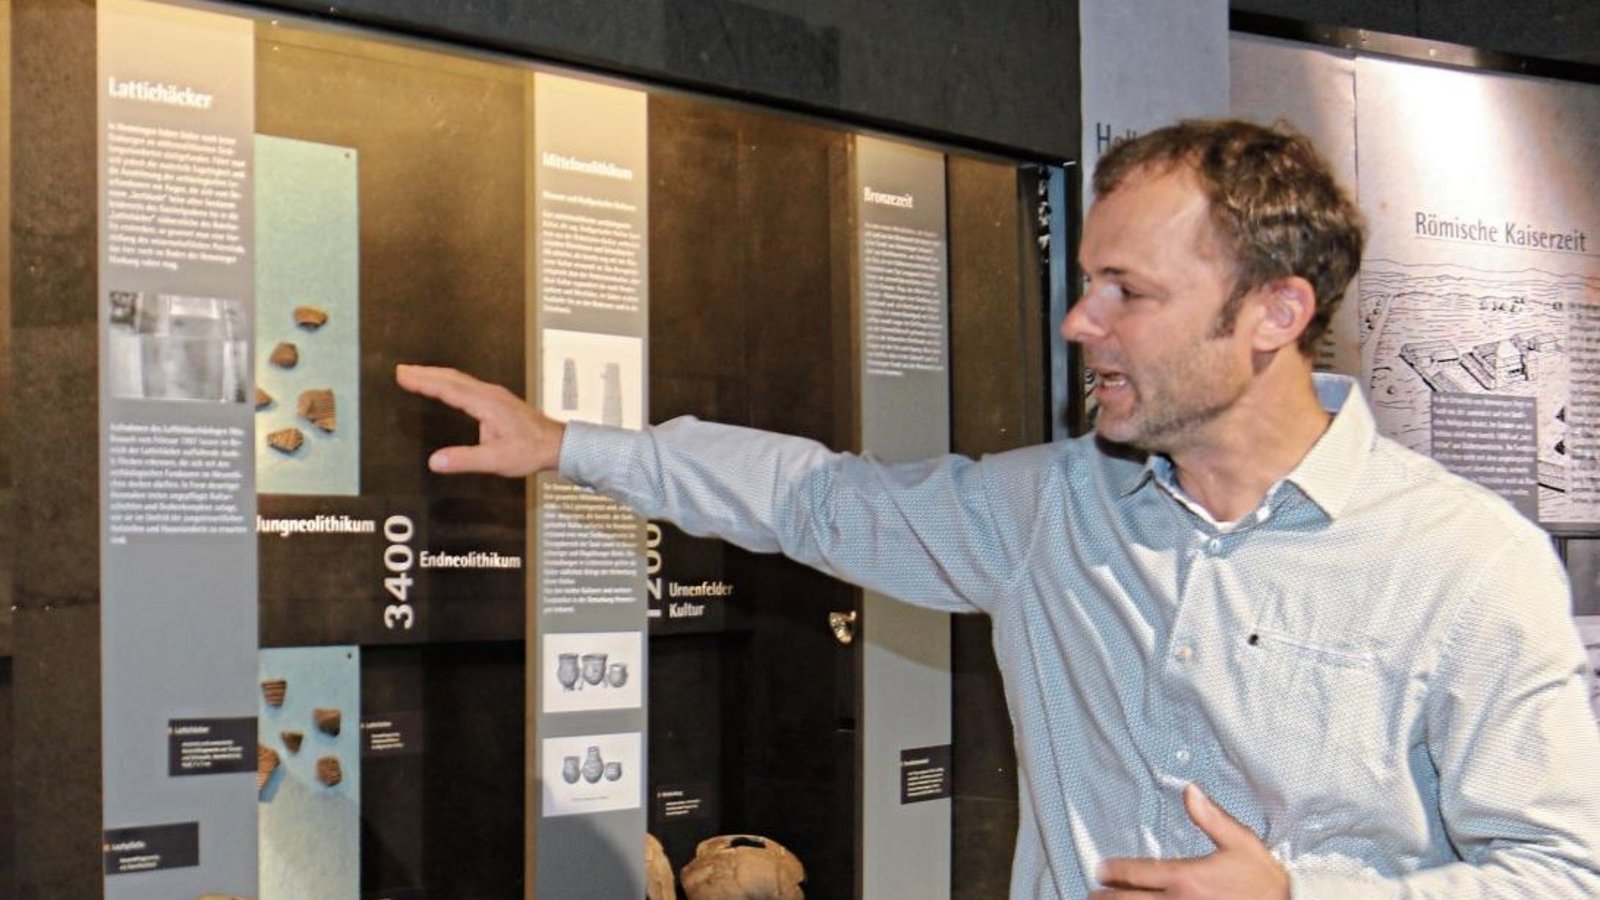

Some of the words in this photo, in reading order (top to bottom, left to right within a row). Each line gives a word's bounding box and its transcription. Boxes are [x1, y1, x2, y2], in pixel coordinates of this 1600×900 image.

[107, 76, 212, 109] Lattichäcker
[863, 186, 914, 209] Bronzezeit
[1415, 211, 1498, 243] Römische
[1504, 222, 1587, 252] Kaiserzeit
[256, 515, 376, 538] Jungneolithikum
[419, 551, 522, 569] Endneolithikum
[384, 514, 414, 630] 3400
[669, 581, 734, 598] Urnenfelder
[669, 602, 705, 618] Kultur
